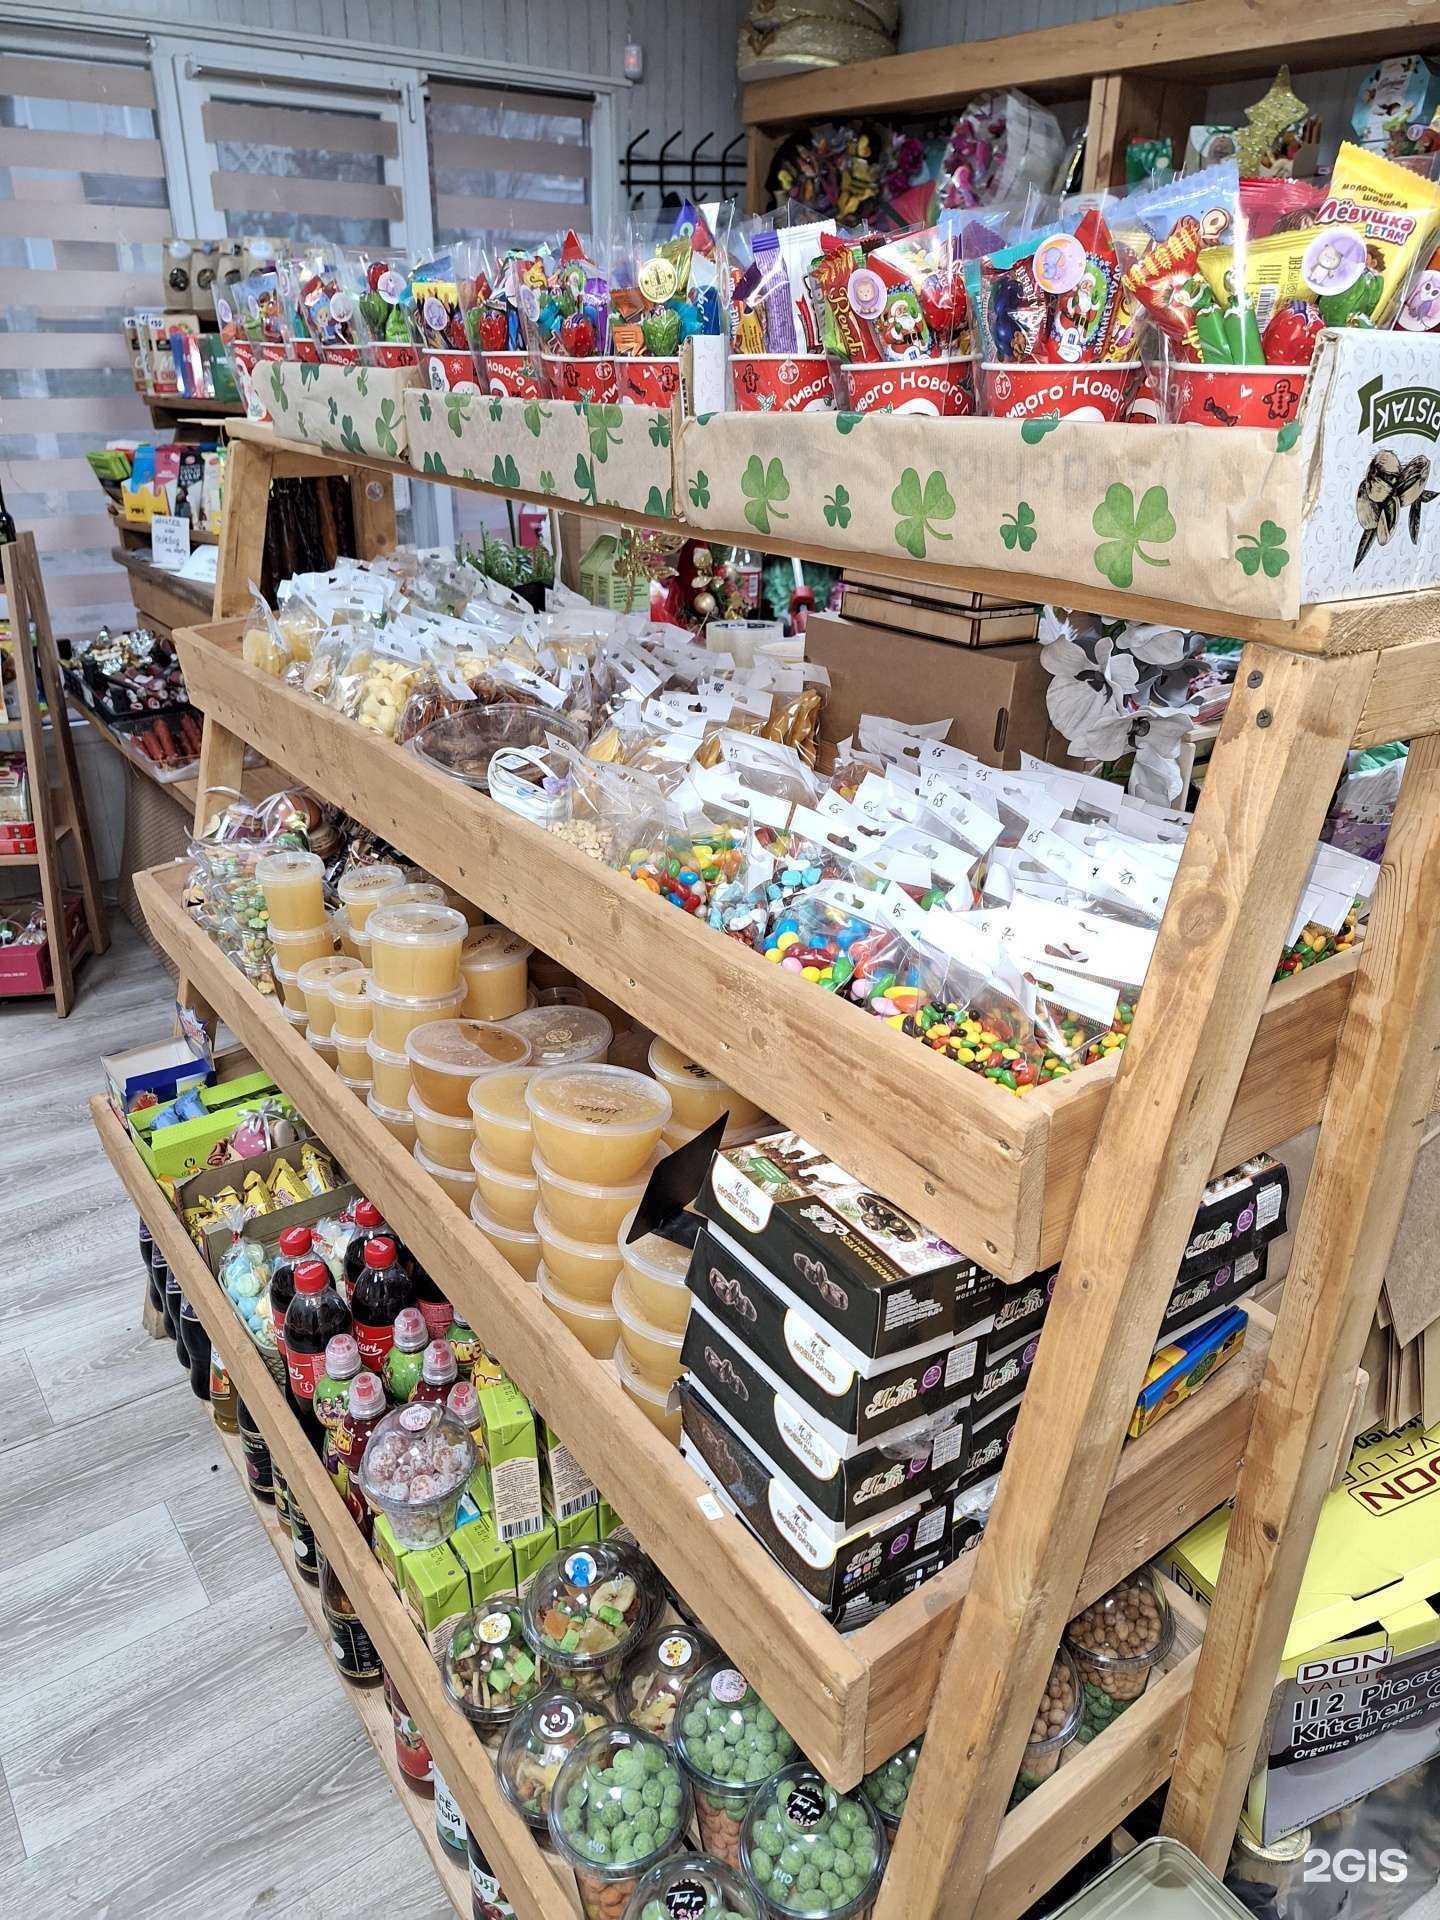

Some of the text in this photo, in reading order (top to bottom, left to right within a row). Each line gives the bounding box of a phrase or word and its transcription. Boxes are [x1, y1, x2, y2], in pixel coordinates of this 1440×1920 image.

[1365, 223, 1406, 243] ДЕТЯМ
[1093, 302, 1114, 355] ЗИМНЕЕ
[900, 370, 964, 406] Нового
[1303, 1650, 1388, 1681] DON
[1291, 1695, 1416, 1747] Kitchen
[1293, 1738, 1350, 1760] Organize
[1354, 1729, 1379, 1744] Your
